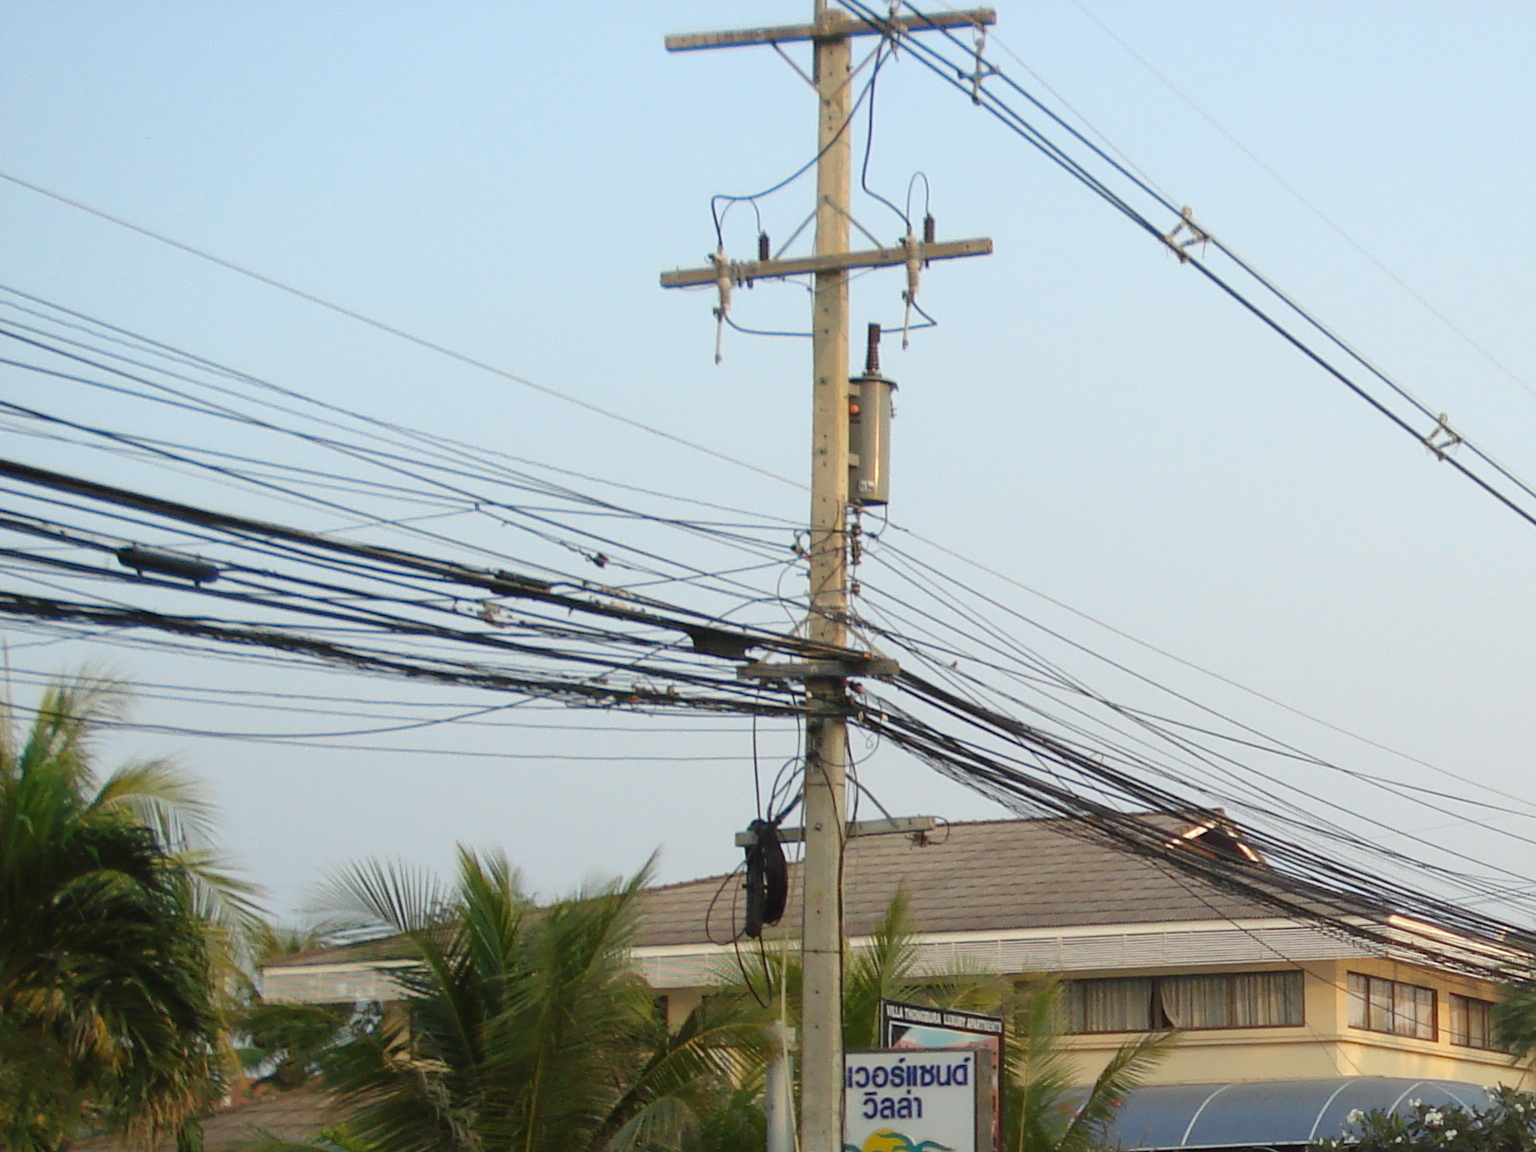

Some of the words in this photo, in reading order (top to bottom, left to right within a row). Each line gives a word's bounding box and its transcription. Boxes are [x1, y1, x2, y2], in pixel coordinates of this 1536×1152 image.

[886, 1004, 904, 1019] VILLA
[862, 1089, 923, 1120] วิลล่า
